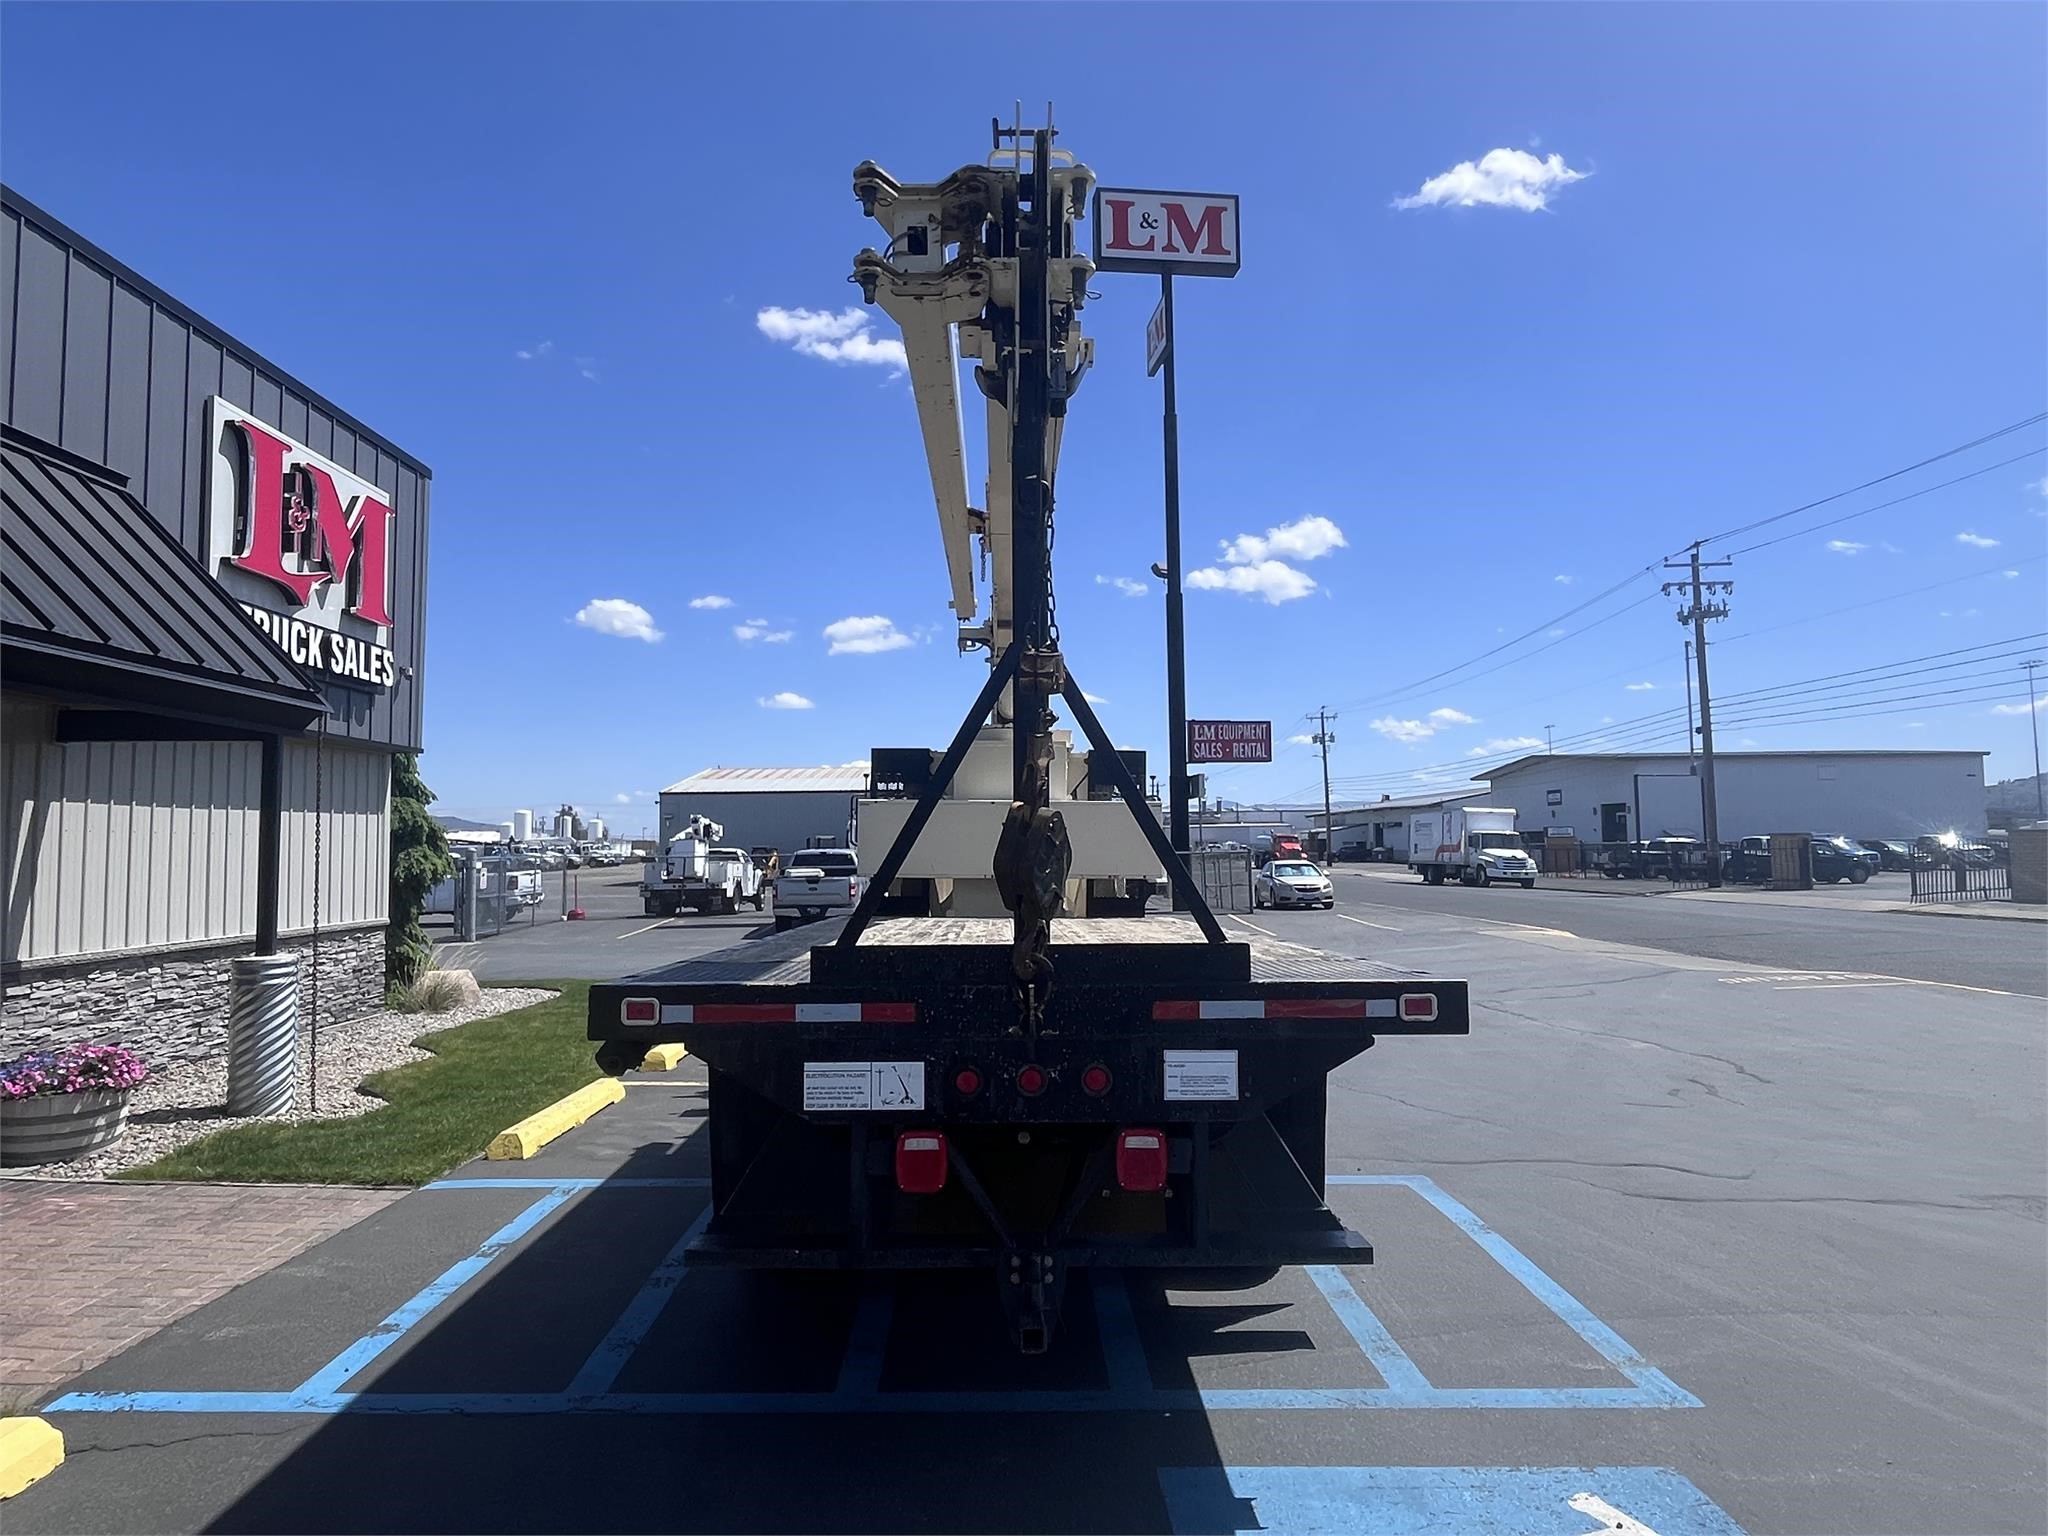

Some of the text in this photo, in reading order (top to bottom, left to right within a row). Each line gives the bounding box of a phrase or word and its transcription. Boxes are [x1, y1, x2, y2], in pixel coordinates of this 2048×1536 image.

[1105, 200, 1231, 255] L&M
[231, 419, 395, 628] L&M
[239, 603, 394, 688] RUCK SALES
[1194, 743, 1267, 758] SALES RENTAL
[1218, 724, 1267, 740] EQUIPMENT
